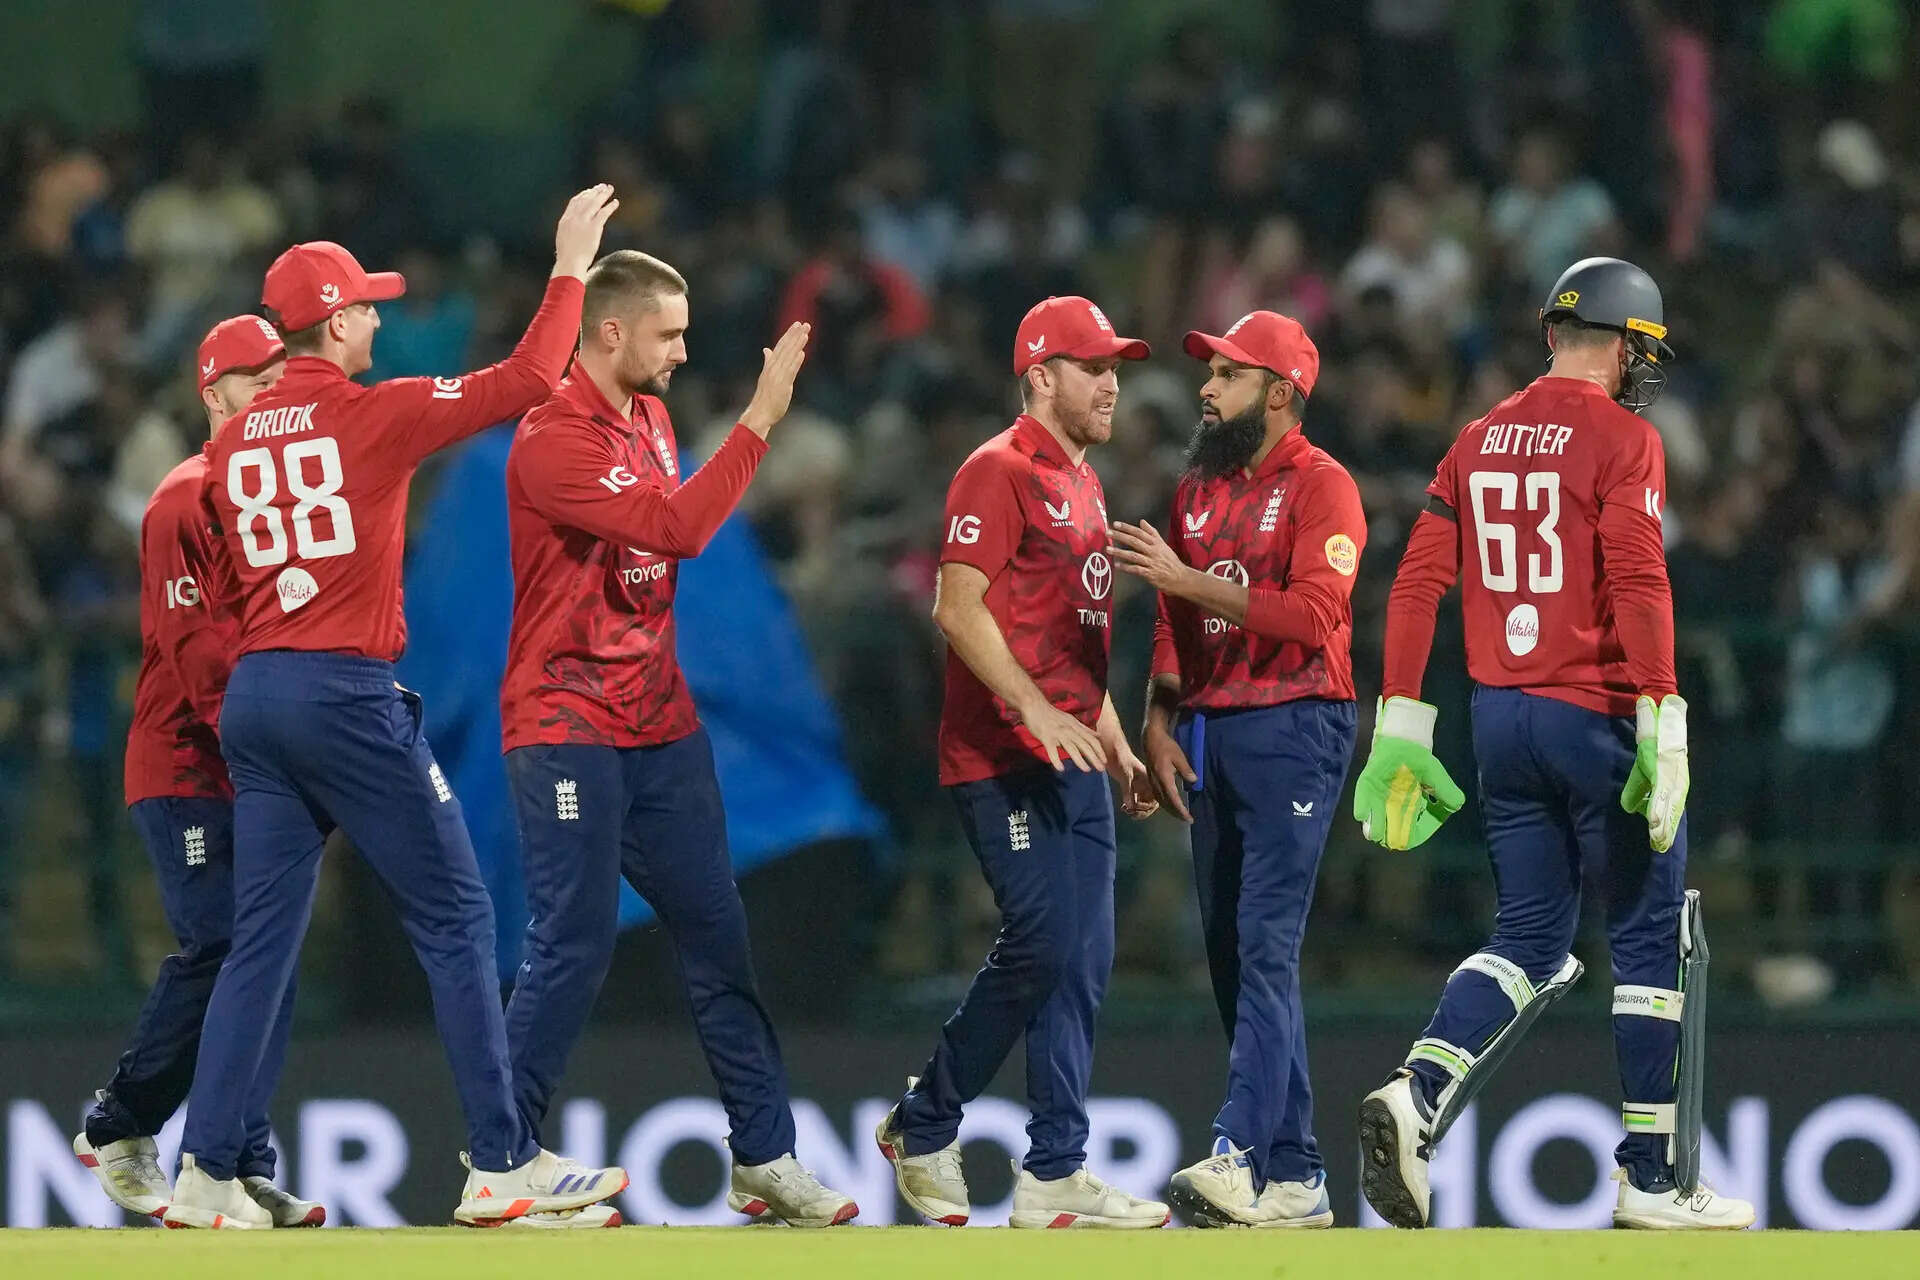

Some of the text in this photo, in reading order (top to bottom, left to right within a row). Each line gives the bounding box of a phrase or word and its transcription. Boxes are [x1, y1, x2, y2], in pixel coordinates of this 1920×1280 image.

[244, 402, 318, 441] BROOK
[1480, 423, 1574, 457] BUTTLER
[598, 465, 638, 494] IG
[227, 436, 357, 568] 88
[947, 514, 982, 545] IG
[1468, 471, 1563, 594] 63
[622, 560, 667, 585] TOYOTA
[166, 576, 200, 609] IG
[1077, 608, 1109, 628] TOYOTA
[1203, 617, 1240, 634] TOY
[1507, 616, 1538, 645] Vitality
[7, 1099, 409, 1228] NR
